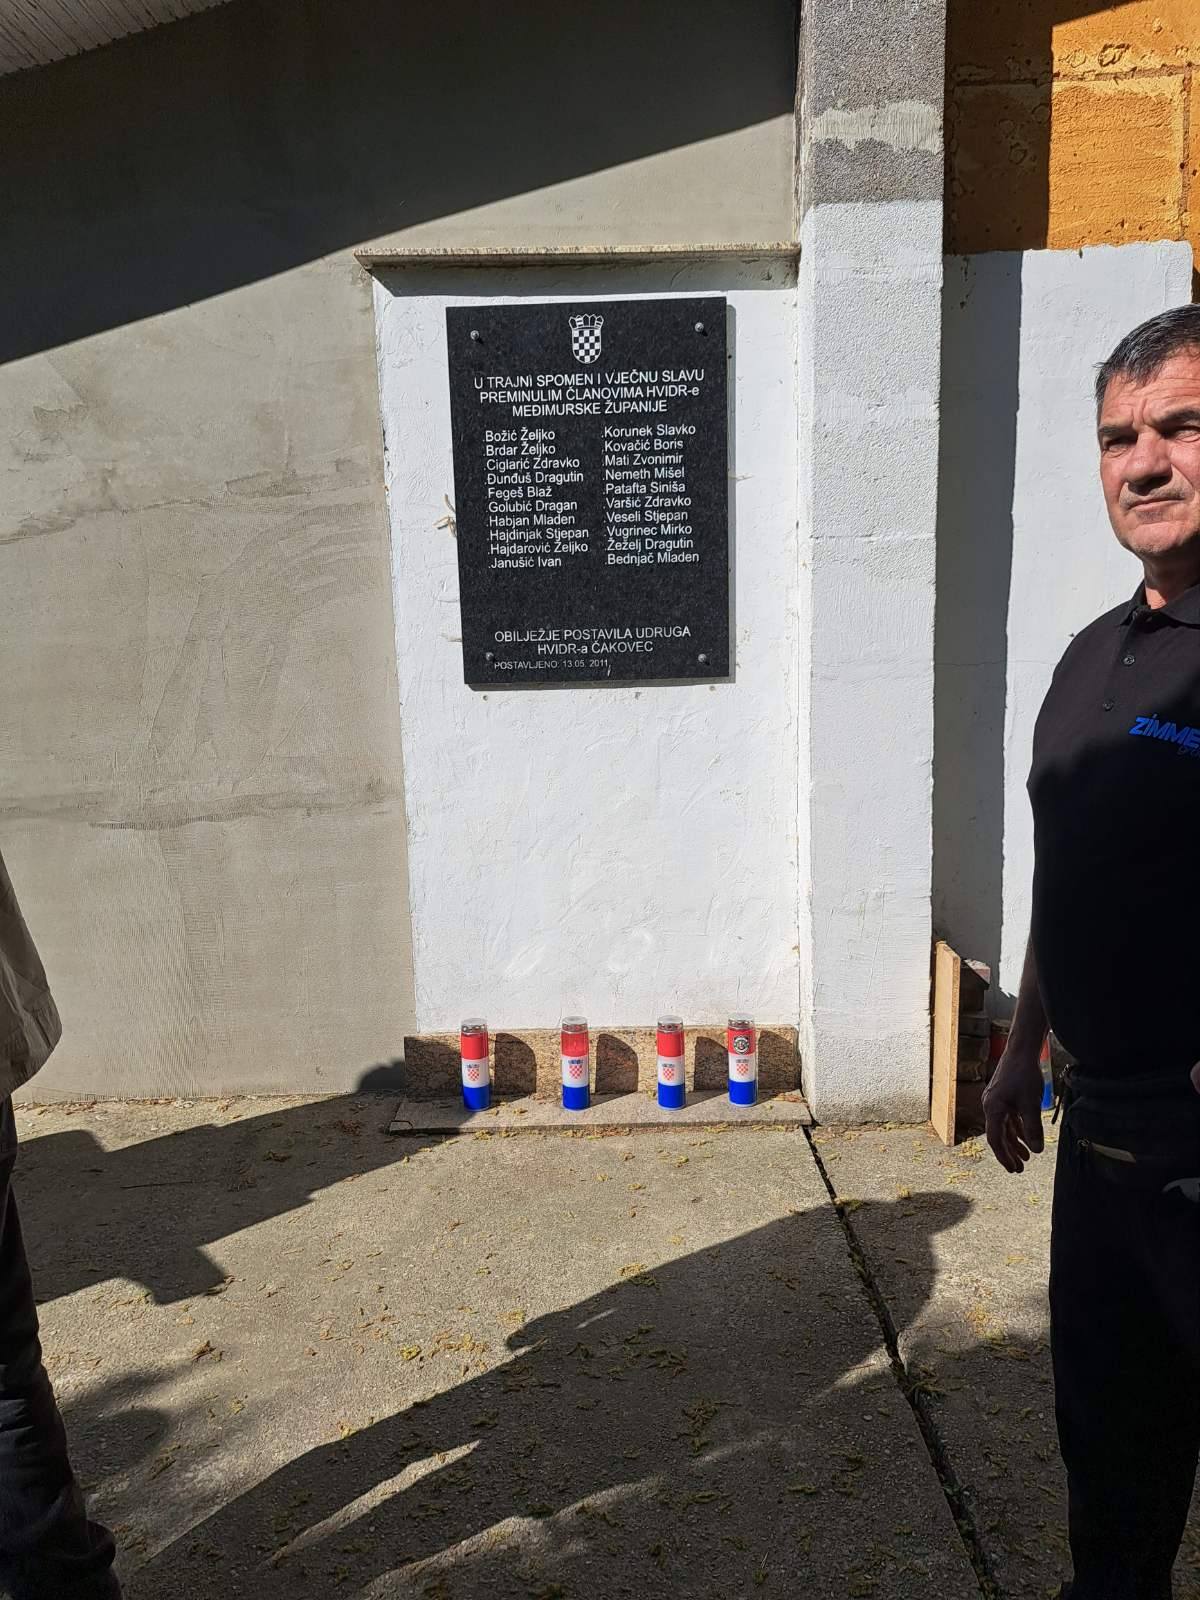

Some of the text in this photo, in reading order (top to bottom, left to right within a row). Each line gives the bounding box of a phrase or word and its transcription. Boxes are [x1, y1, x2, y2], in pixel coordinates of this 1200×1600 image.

[474, 369, 705, 389] U TRAJNI SPOMEN I VJEČNU SLAVU
[480, 384, 700, 403] PREMINULIM ČLANOVIMA HVIDR-e
[512, 399, 668, 417] MEĐIMURSKE ŽUPANIJE
[520, 426, 555, 443] Željko
[656, 423, 696, 436] Slavko
[521, 441, 556, 457] Željko
[654, 438, 684, 450] Boris
[533, 456, 580, 469] Zdravko
[633, 452, 684, 465] Zvonimir
[535, 470, 584, 485] Dragutin
[654, 466, 685, 479] Mišel
[527, 486, 552, 497] Blaž
[650, 481, 686, 493] Siniša
[535, 500, 578, 513] Dragan
[644, 495, 692, 508] Zdravko
[533, 514, 576, 525] Mladen
[644, 510, 688, 524] Stjepan
[545, 527, 589, 541] Stjepan
[660, 524, 693, 535] Mirko
[645, 537, 694, 552] Dragutin
[537, 556, 562, 567] Ivan
[657, 551, 700, 563] Mladen
[494, 625, 692, 642] OBILJEŽJE POSTAVILA UDRUGA
[537, 639, 654, 655] HVIDR-a ČAKOVEC
